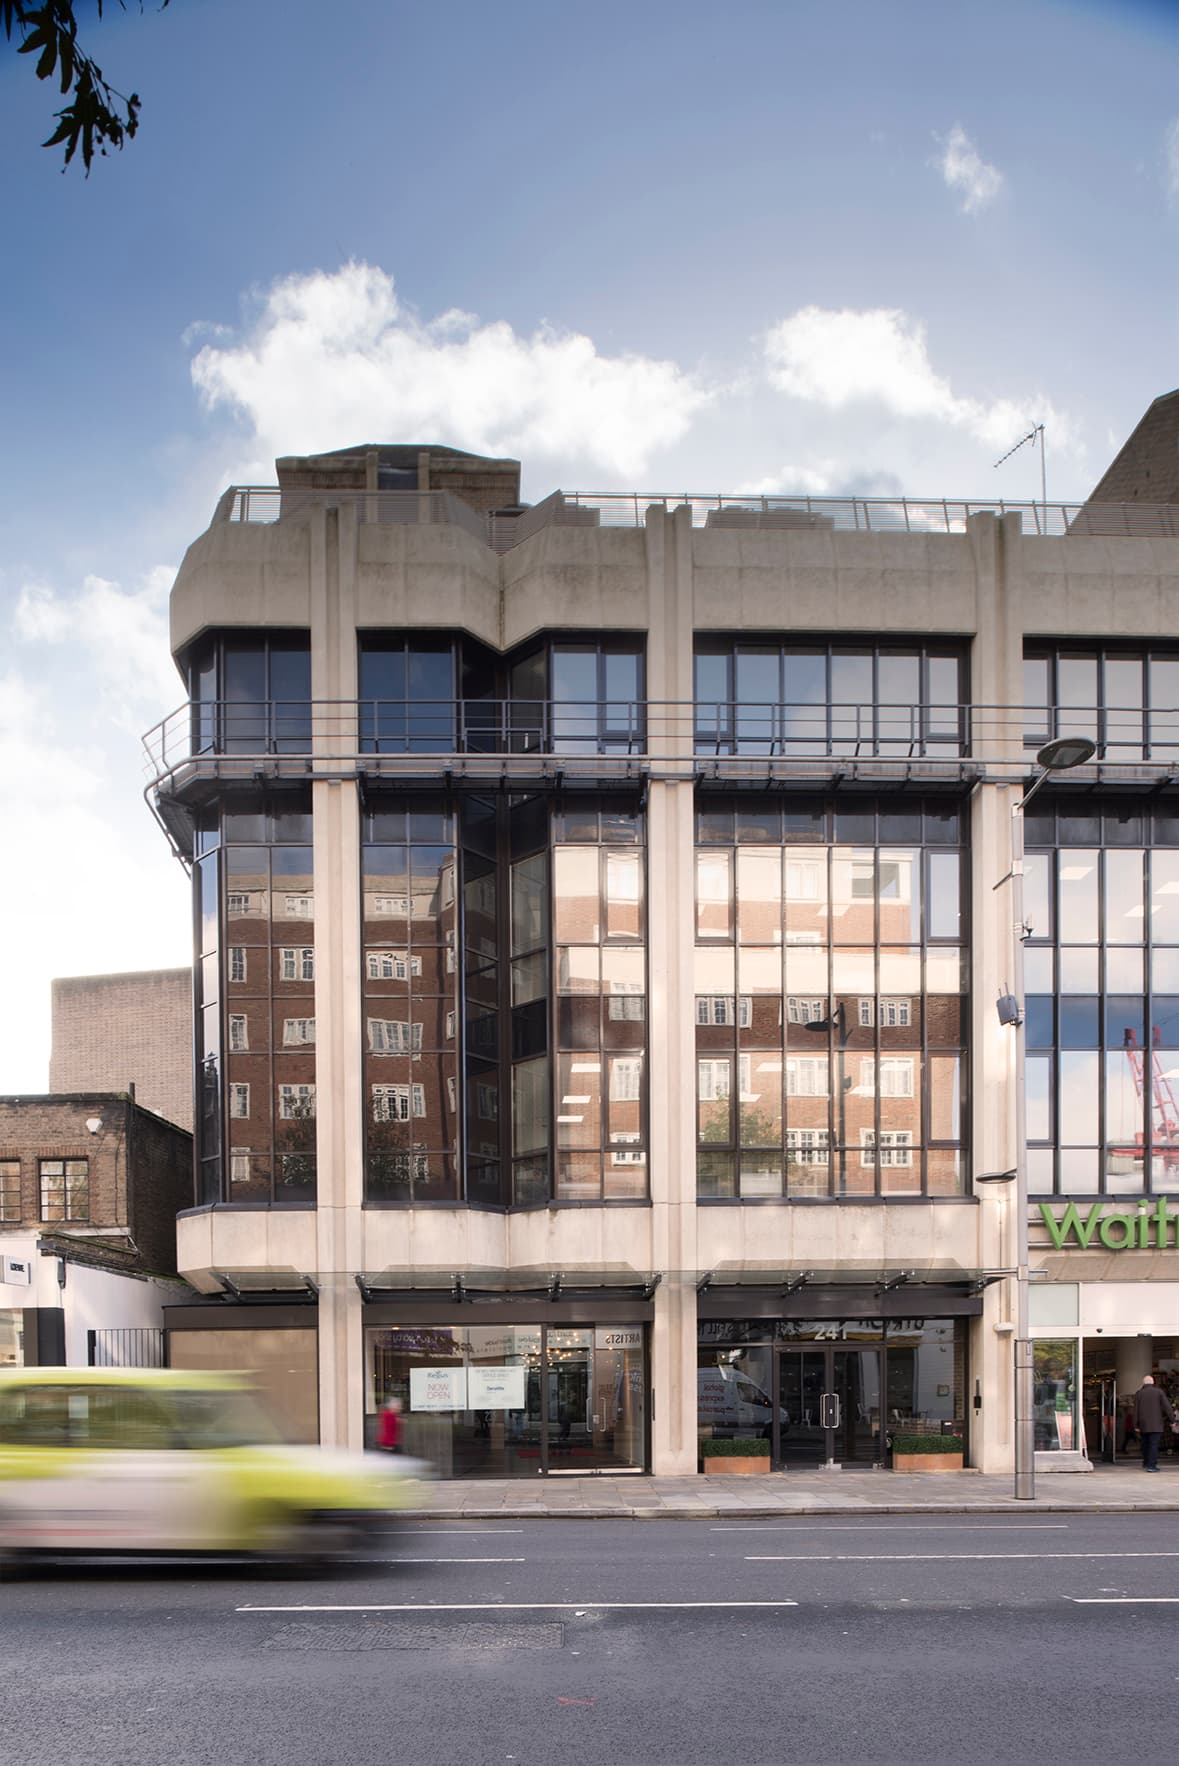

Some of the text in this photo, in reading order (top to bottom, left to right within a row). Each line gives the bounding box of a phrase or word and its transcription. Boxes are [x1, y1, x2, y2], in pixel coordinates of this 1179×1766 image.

[1039, 1196, 1179, 1250] Wait
[814, 1324, 846, 1340] 241
[427, 1383, 449, 1391] NOW
[427, 1391, 451, 1400] OPEN
